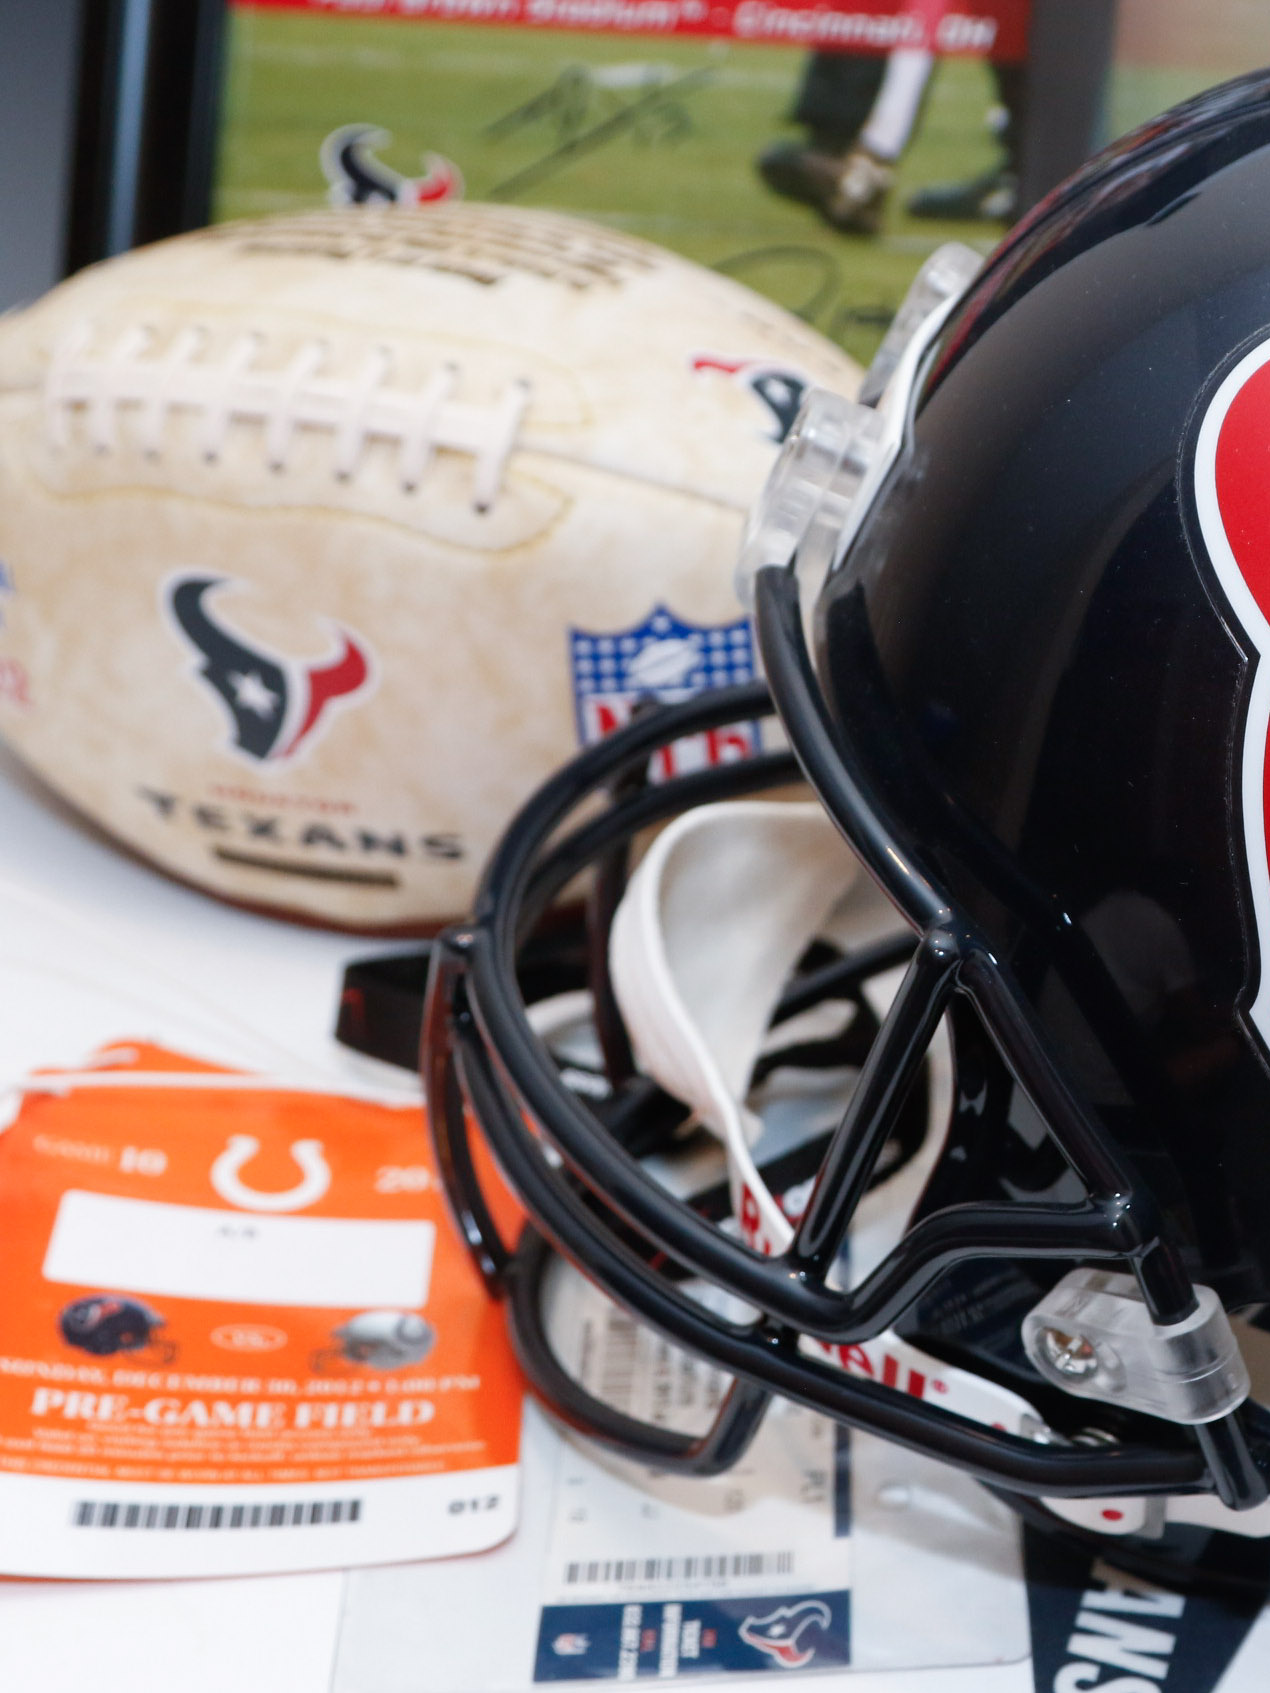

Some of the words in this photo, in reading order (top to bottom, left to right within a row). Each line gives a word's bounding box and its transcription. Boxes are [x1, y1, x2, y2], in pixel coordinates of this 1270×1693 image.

[138, 786, 462, 860] TEXANS
[31, 1386, 286, 1428] PRE-GAME
[294, 1400, 436, 1428] FIELD
